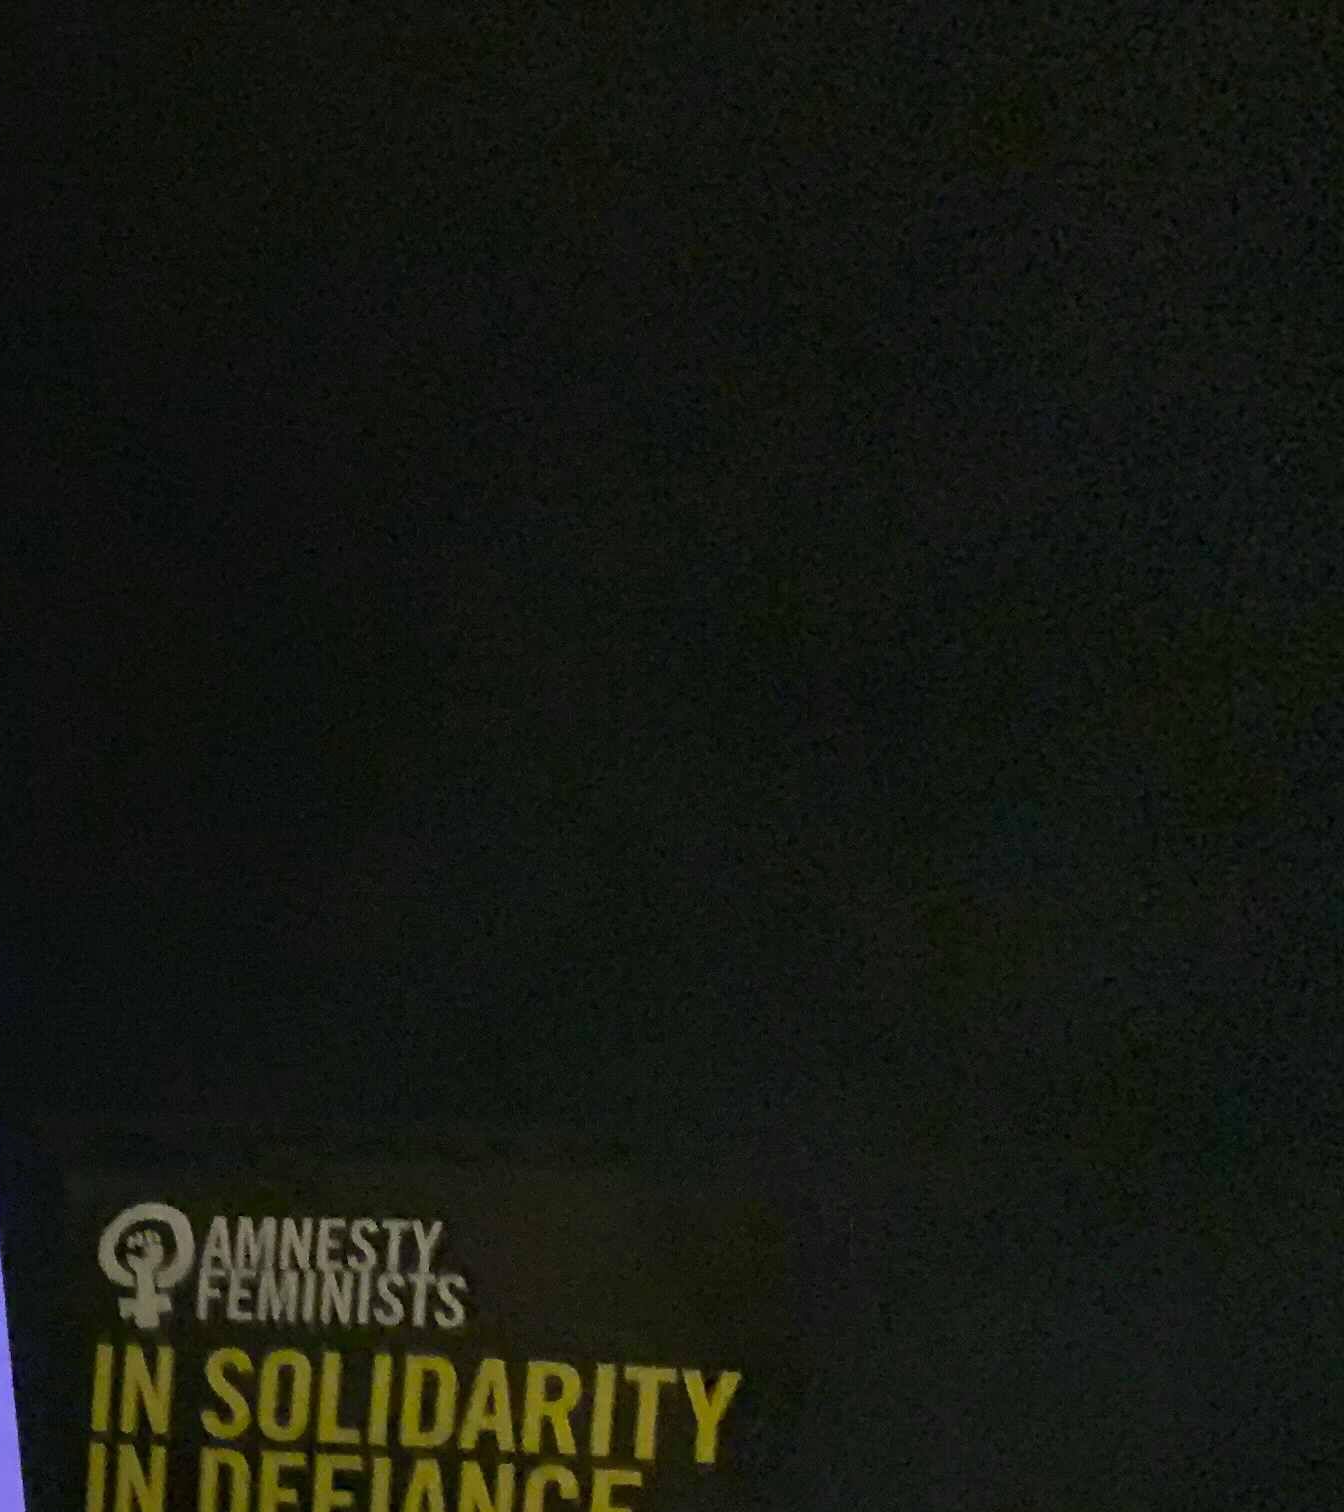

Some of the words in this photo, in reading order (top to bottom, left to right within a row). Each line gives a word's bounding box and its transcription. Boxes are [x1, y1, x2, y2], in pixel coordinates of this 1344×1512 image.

[202, 1216, 444, 1272] AMNESTY
[196, 1268, 468, 1329] FEMINISTS
[92, 1344, 174, 1435] IN
[200, 1348, 742, 1464] SOLIDARITY
